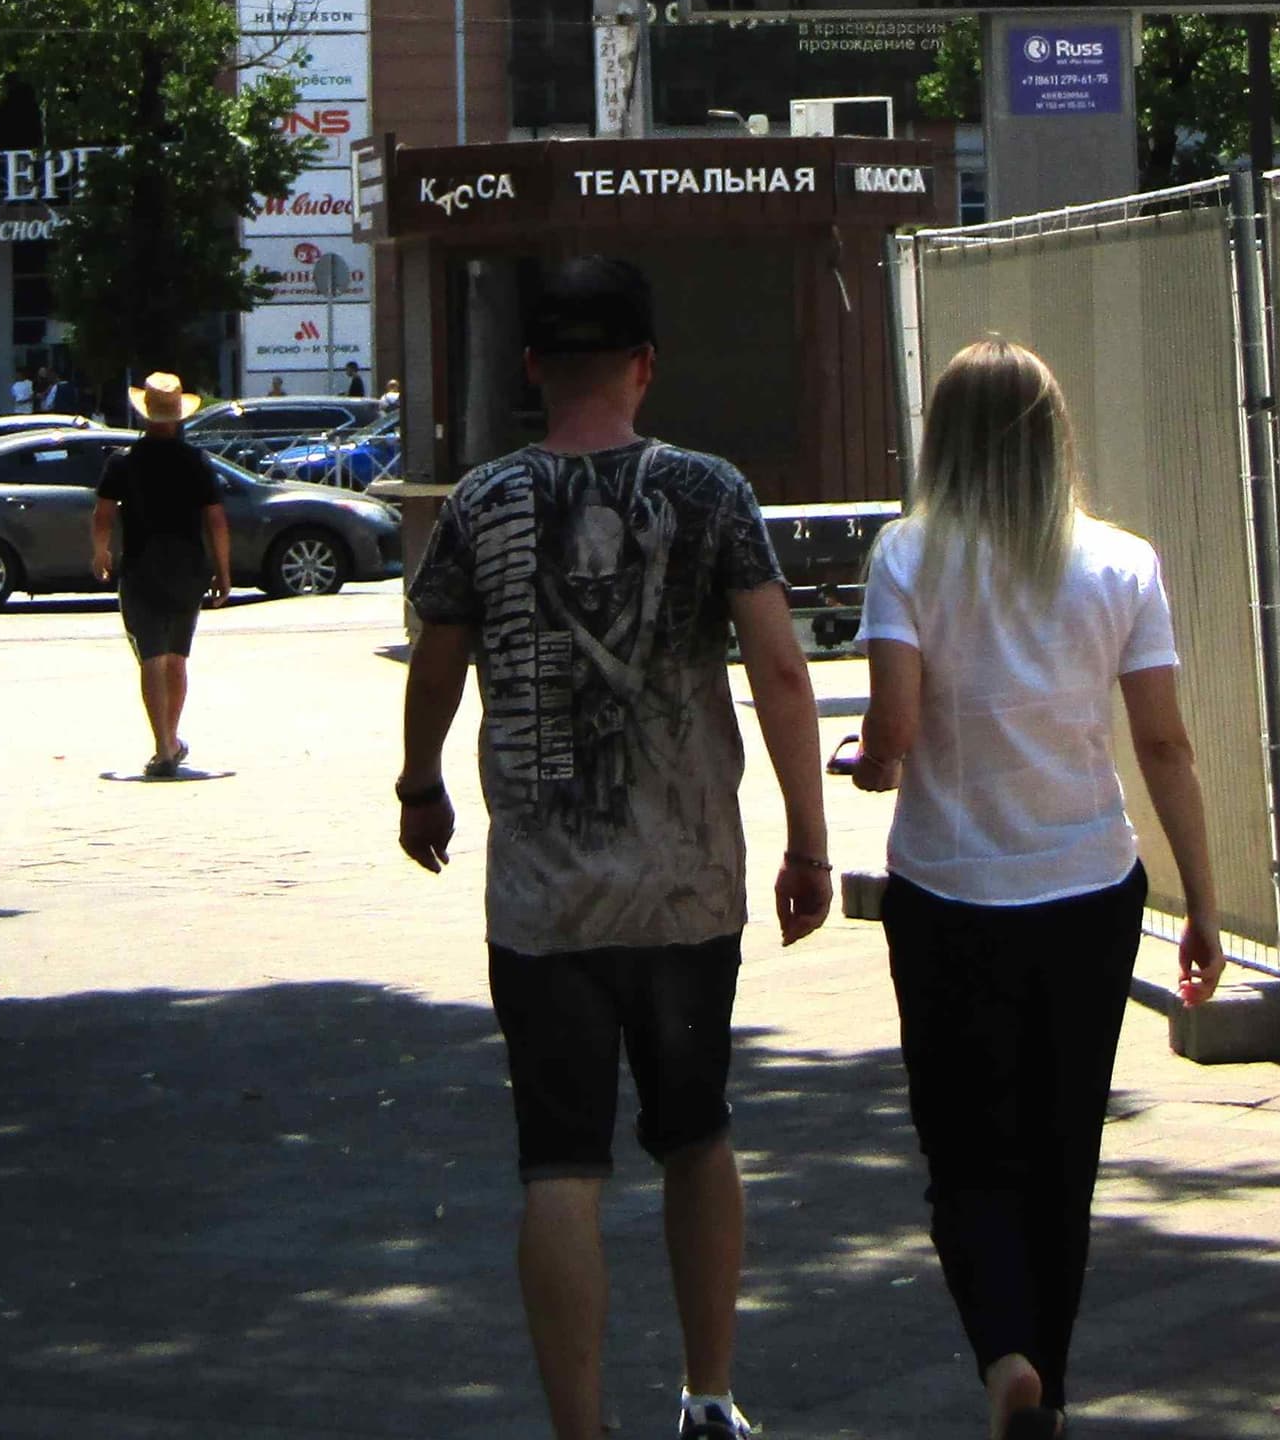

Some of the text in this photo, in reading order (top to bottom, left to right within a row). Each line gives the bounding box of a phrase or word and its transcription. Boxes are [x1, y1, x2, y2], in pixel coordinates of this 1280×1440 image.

[255, 11, 353, 23] HENDERSON
[600, 43, 617, 57] 21
[798, 38, 917, 54] прохождение
[1055, 40, 1104, 57] Russ
[575, 166, 816, 196] ТЕАТРАЛЬНАЯ
[855, 165, 927, 193] КАССА
